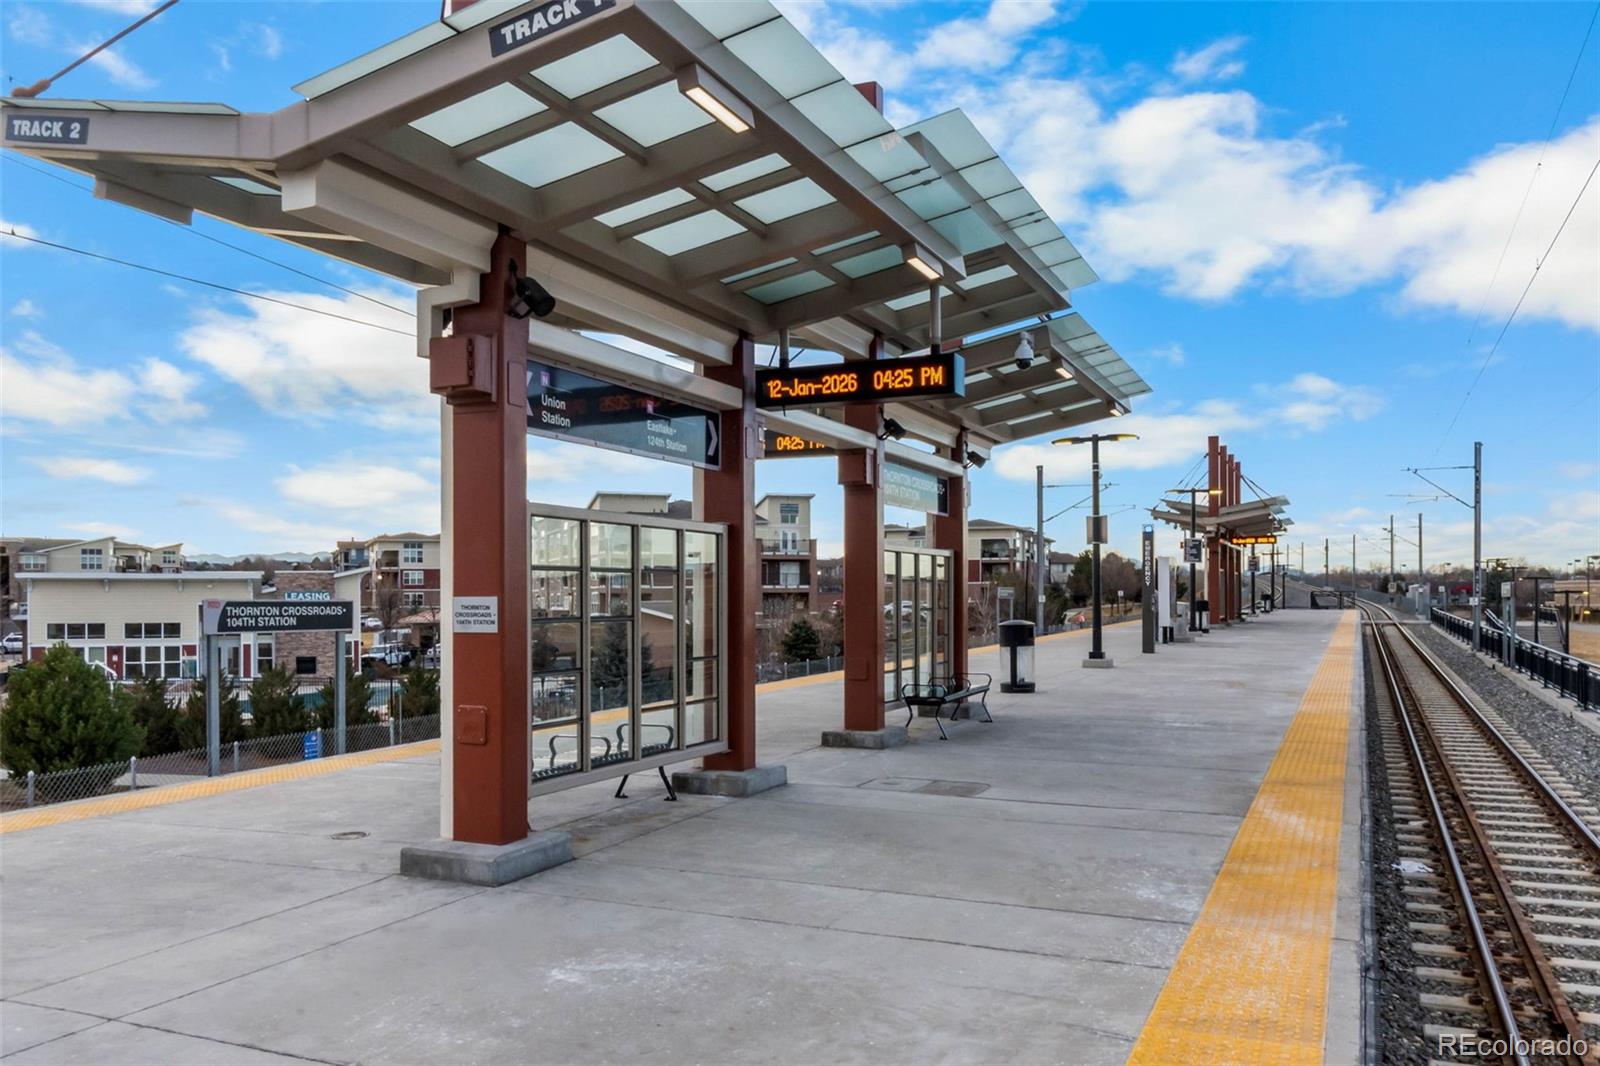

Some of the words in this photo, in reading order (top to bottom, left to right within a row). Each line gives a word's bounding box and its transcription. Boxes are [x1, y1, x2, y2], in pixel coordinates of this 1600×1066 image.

[501, 0, 581, 45] TRACK
[13, 119, 63, 138] TRACK
[69, 121, 81, 139] 2
[767, 373, 858, 399] 12-Jan-2026
[873, 368, 913, 390] 04:25
[920, 365, 943, 387] PM
[541, 393, 566, 411] Union
[541, 410, 571, 429] Station
[647, 434, 665, 449] 124th
[665, 436, 688, 453] Station
[284, 592, 331, 601] LEASING
[226, 606, 280, 616] THORNTON
[226, 617, 256, 627] 104TH
[257, 616, 297, 626] STATION
